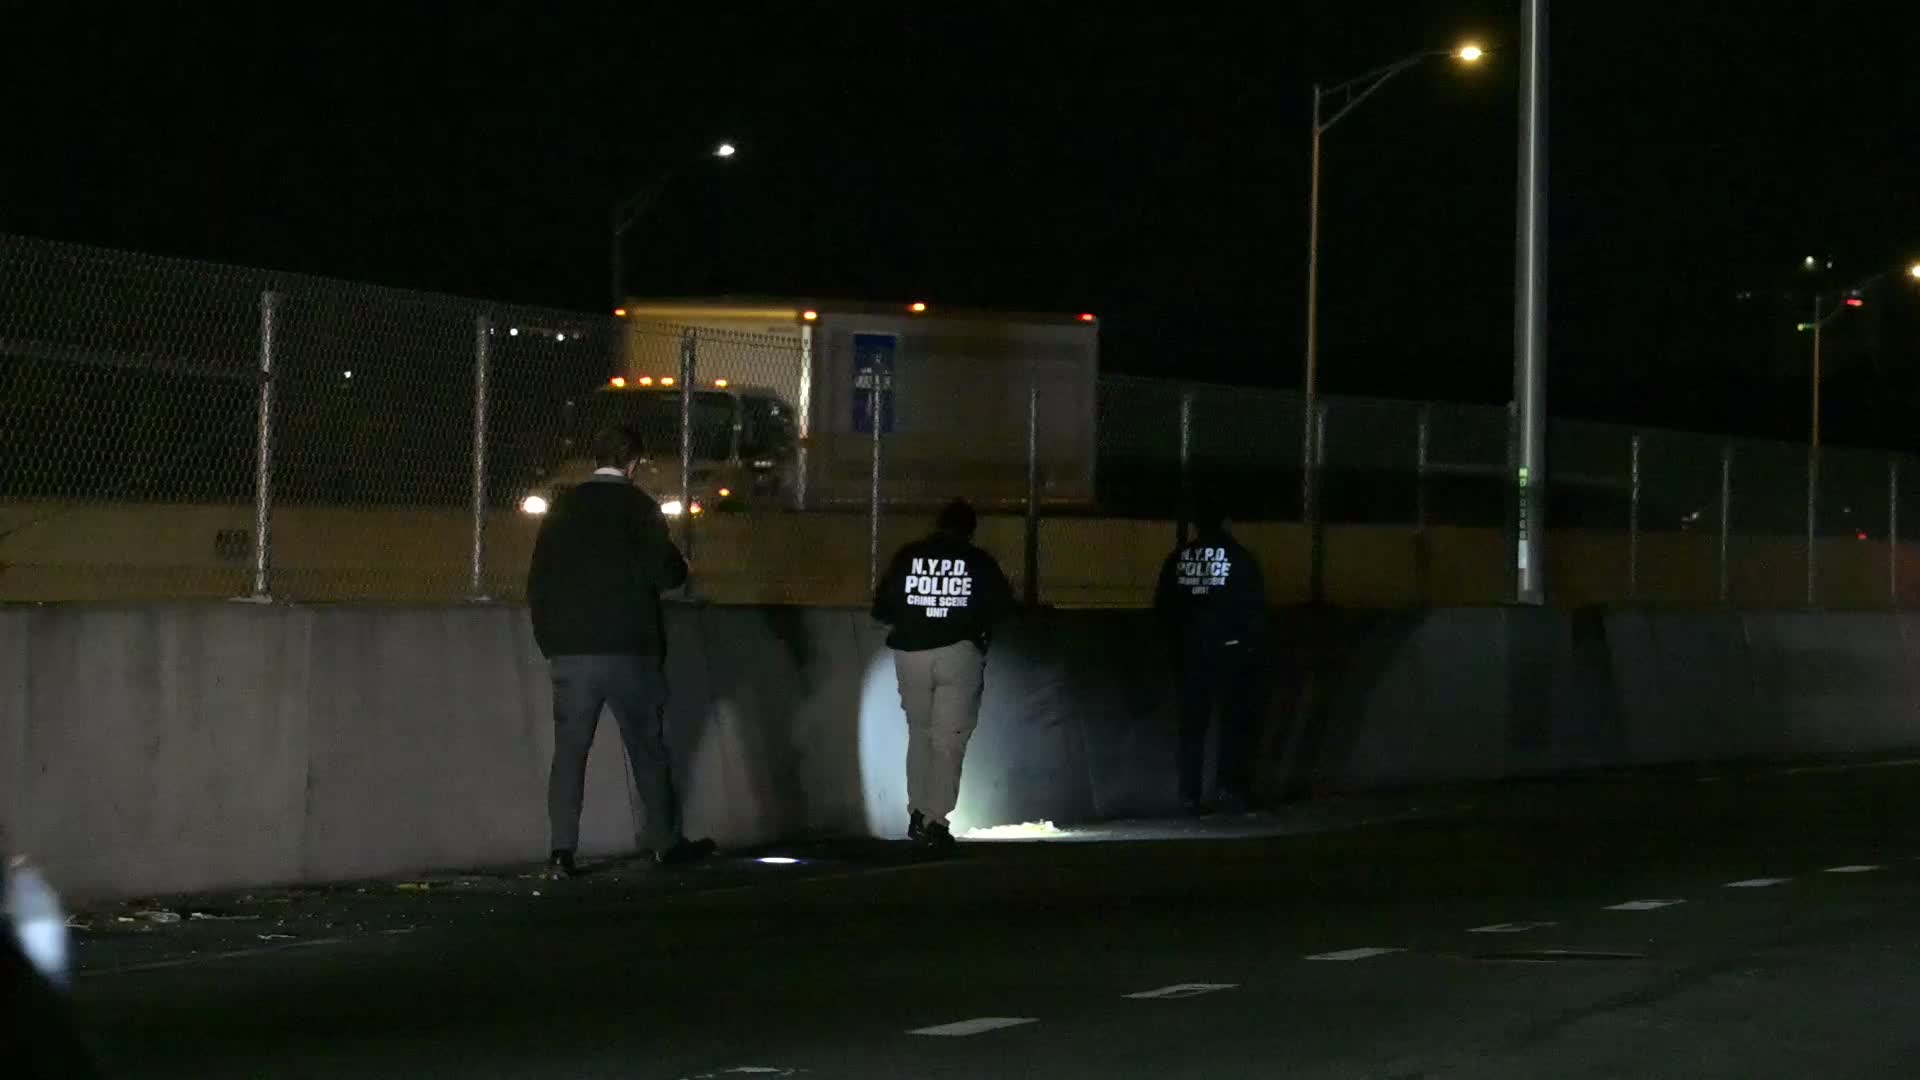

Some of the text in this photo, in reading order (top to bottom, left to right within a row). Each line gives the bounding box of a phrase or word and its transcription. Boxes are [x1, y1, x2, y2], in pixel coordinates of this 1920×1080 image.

[911, 558, 968, 576] N.Y.P.D.
[1176, 562, 1232, 577] POLICE
[905, 575, 972, 595] POLICE
[907, 595, 968, 607] CRIME SCENE
[926, 607, 949, 618] UNIT
